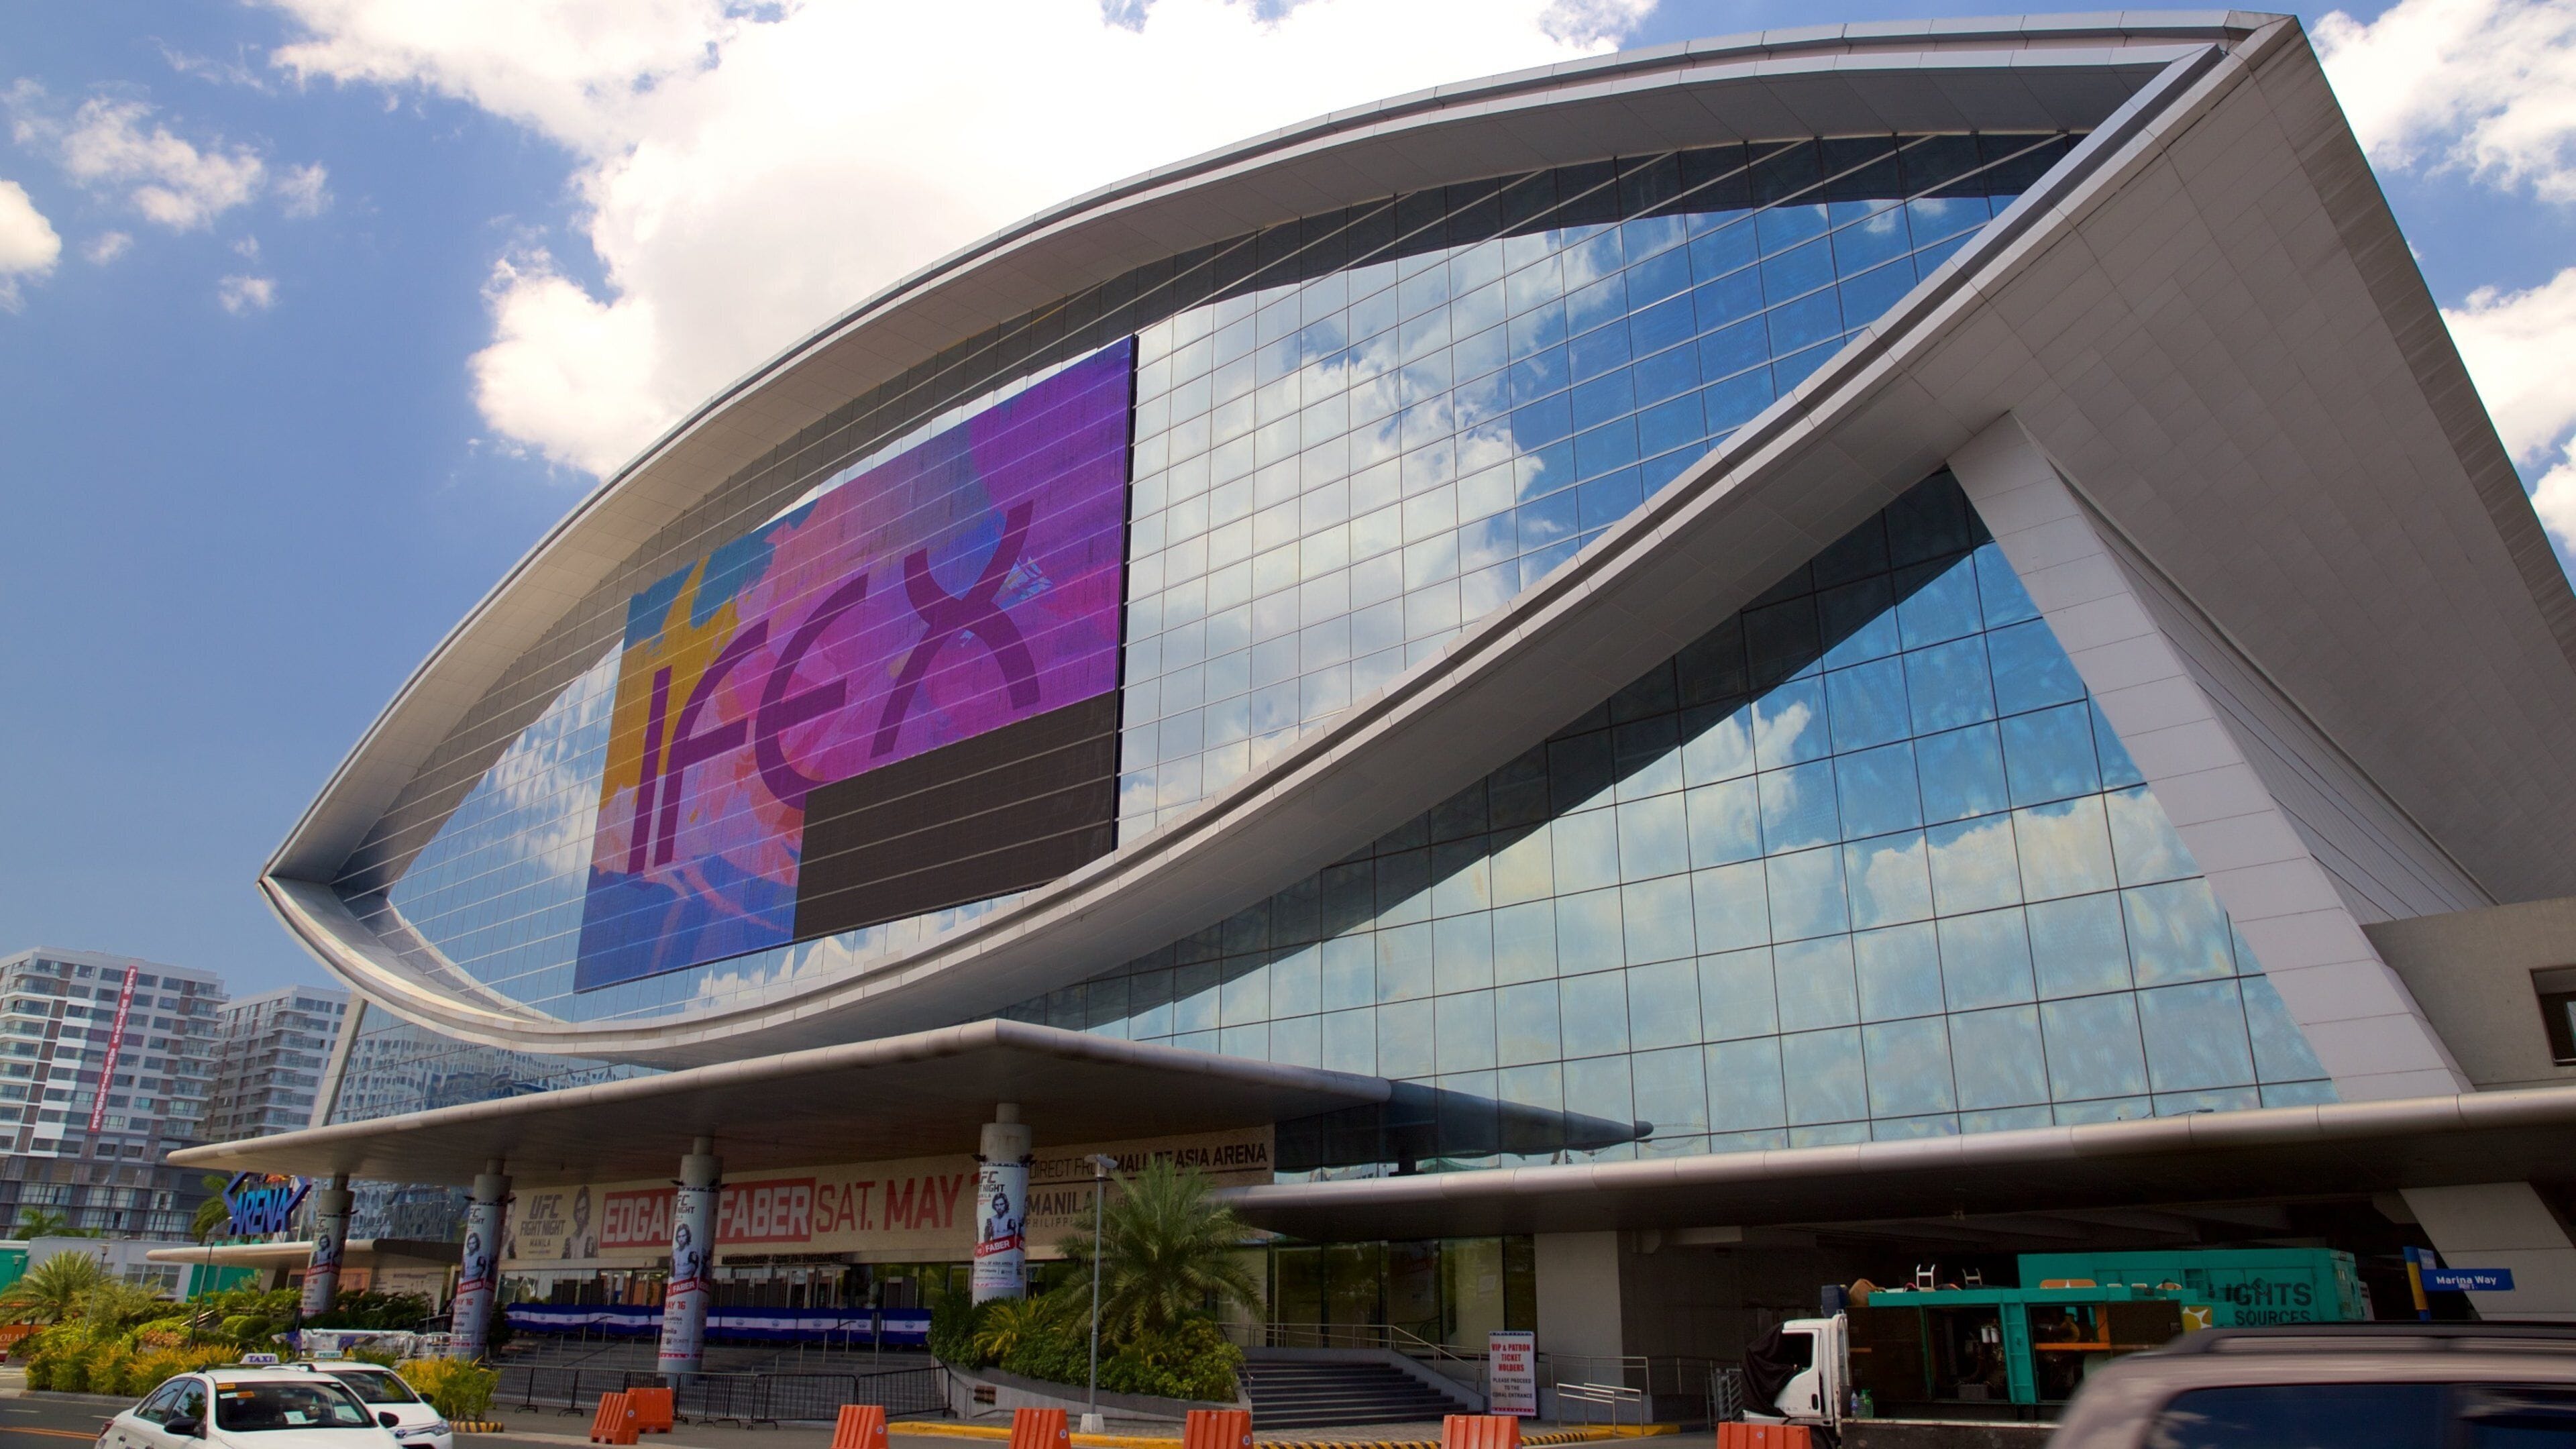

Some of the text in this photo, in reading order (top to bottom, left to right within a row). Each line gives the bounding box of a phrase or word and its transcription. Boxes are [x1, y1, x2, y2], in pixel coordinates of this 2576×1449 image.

[627, 500, 1041, 875] IFEX
[92, 968, 136, 1128] FEW UNITS AVAILABLE
[1030, 1158, 1071, 1179] DIRECT
[1175, 1147, 1209, 1169] ASIA
[1213, 1143, 1268, 1166] ARENA
[979, 1171, 999, 1184] FC
[229, 1187, 290, 1235] ARENA
[529, 1194, 563, 1219] UFC
[715, 1185, 812, 1238] FABER
[816, 1174, 964, 1232] SAT. MAY
[520, 1219, 566, 1236] FIGHT NIGHT
[985, 1240, 1010, 1252] FABER
[673, 1281, 695, 1292] FABER
[2436, 1275, 2497, 1285] Marina Way
[2226, 1282, 2312, 1305] IGHTS
[1508, 1344, 1531, 1352] PATRON
[1498, 1364, 1525, 1372] HOLDERS
